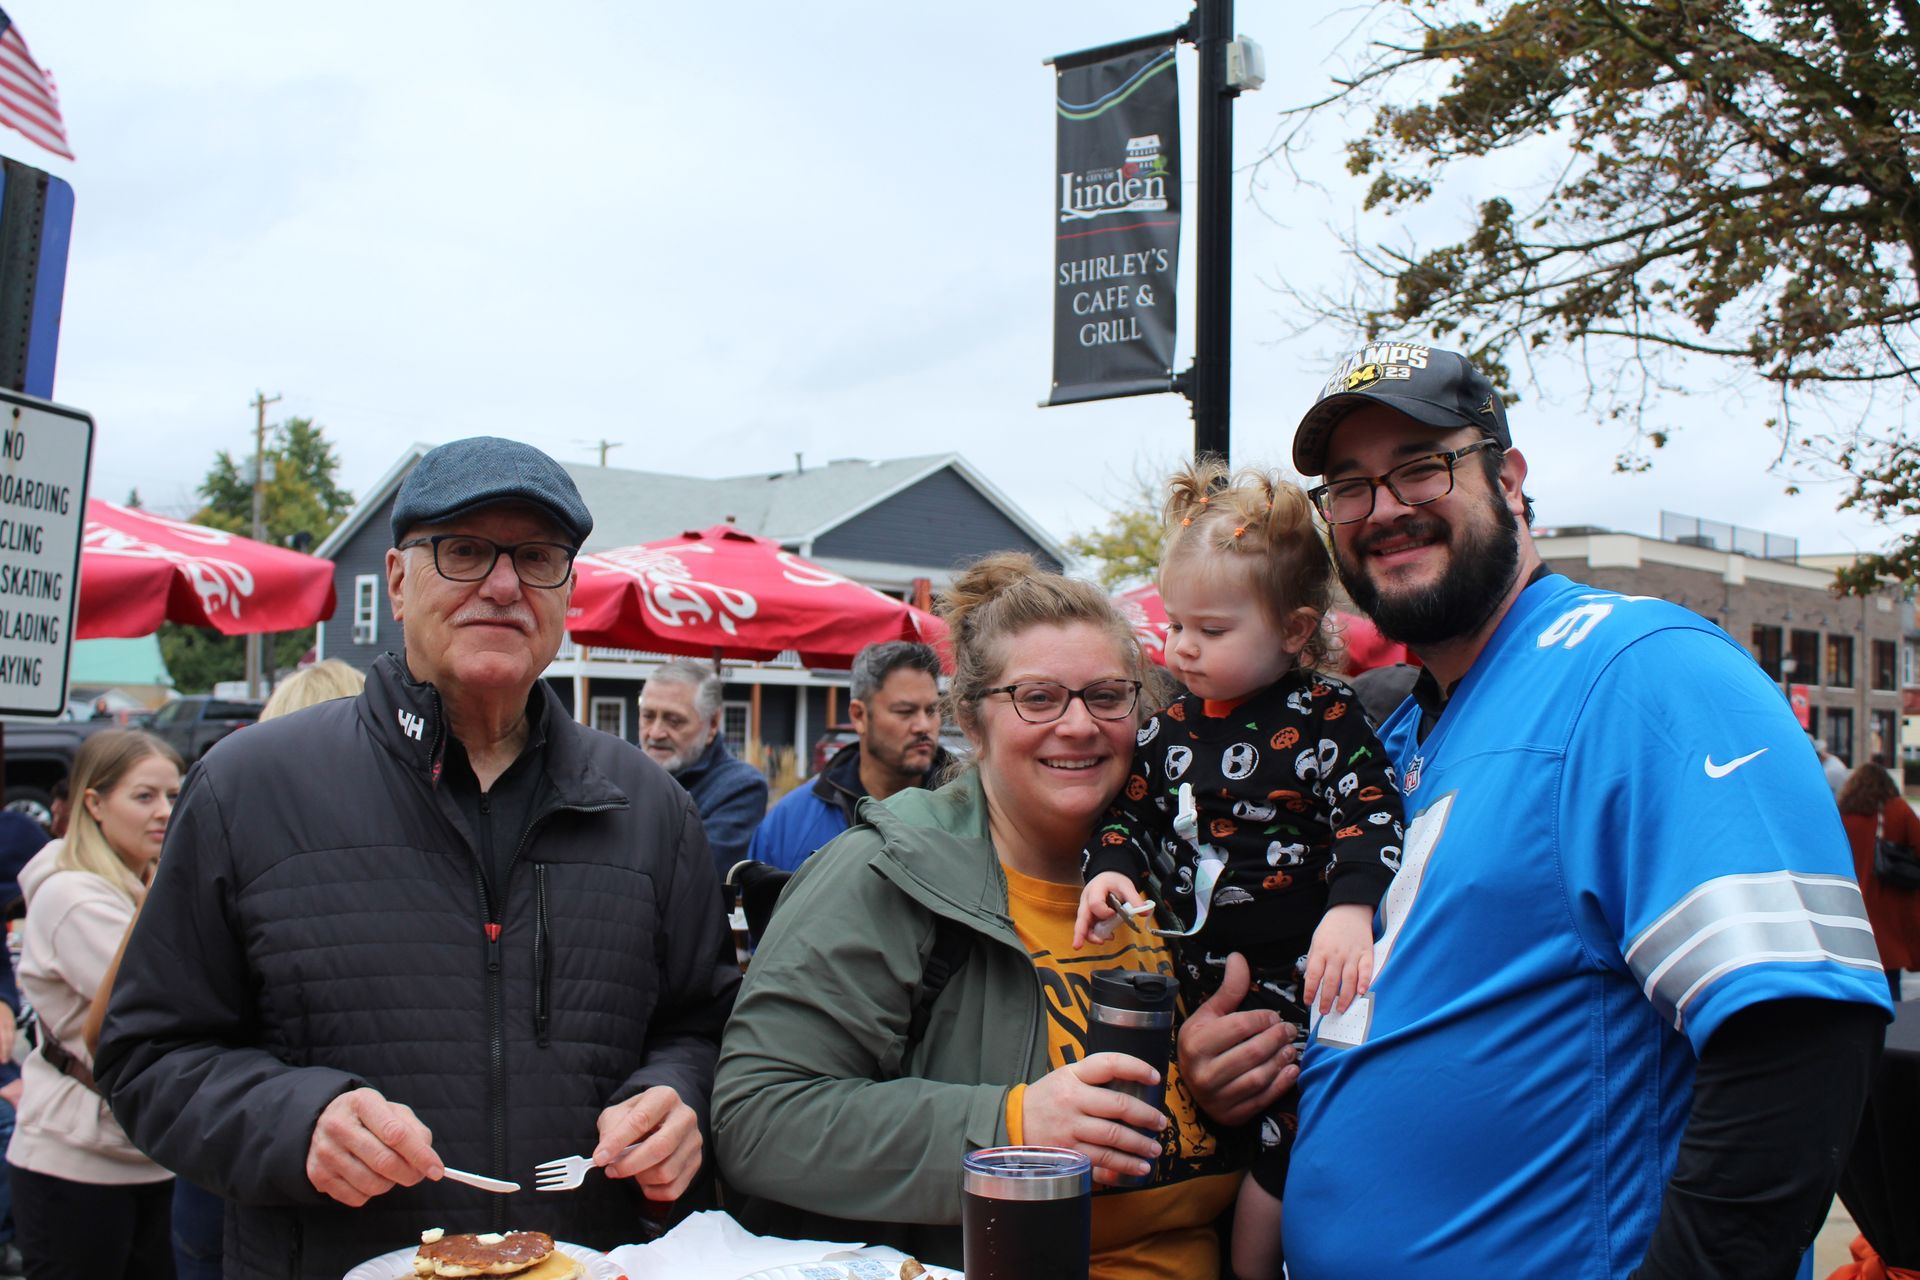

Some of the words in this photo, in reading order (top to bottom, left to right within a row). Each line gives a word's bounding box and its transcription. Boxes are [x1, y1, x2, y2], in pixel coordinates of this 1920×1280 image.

[1060, 168, 1167, 211] Linden
[1059, 248, 1169, 286] SHIRLEY'S
[1073, 285, 1130, 316] CAFE
[1136, 284, 1156, 308] &
[1079, 317, 1142, 347] GRILL
[1348, 364, 1376, 388] M
[1385, 366, 1411, 378] 23
[2, 429, 26, 461] NO
[1, 564, 62, 601] SKATING
[398, 708, 425, 741] HH
